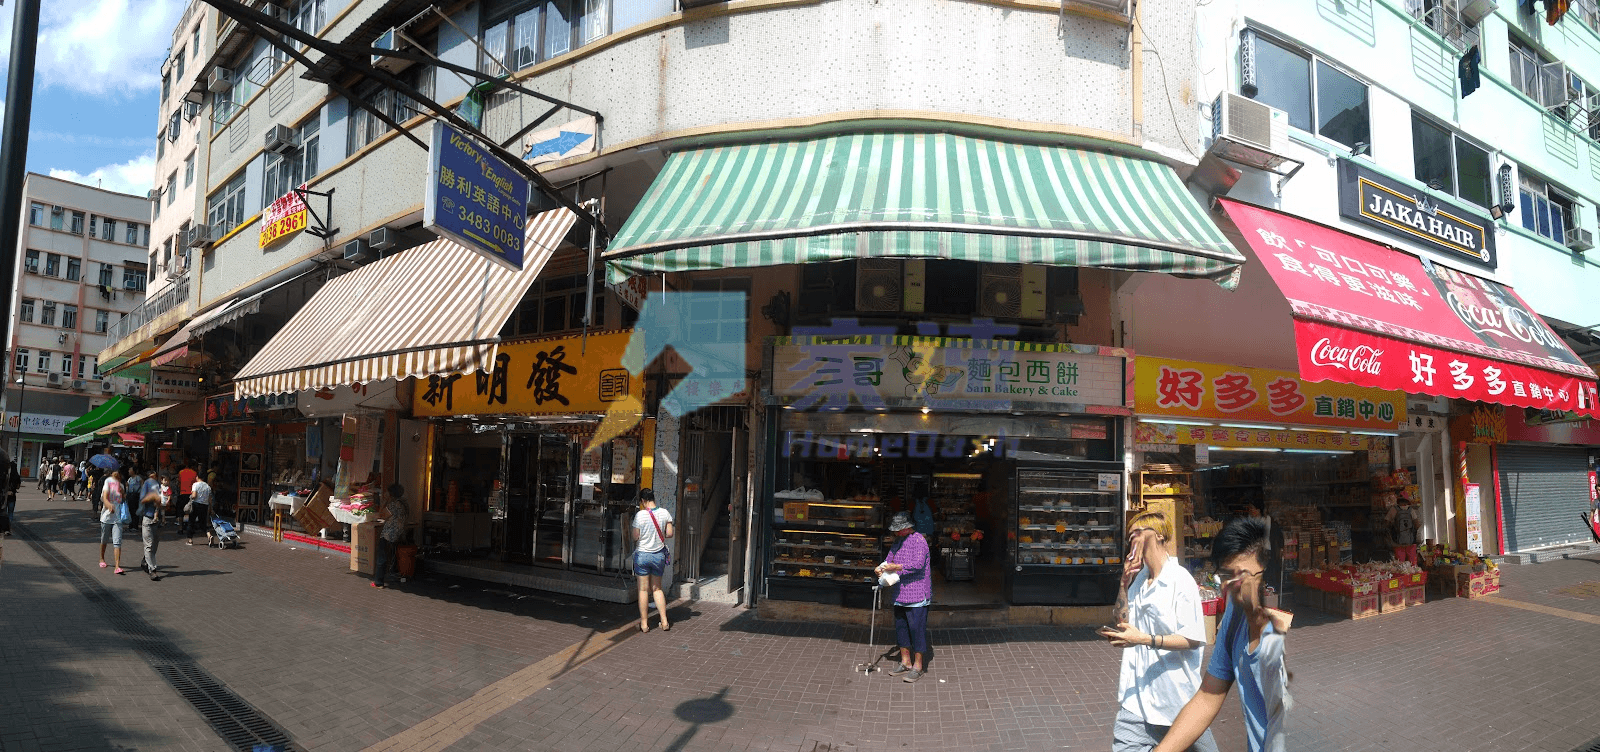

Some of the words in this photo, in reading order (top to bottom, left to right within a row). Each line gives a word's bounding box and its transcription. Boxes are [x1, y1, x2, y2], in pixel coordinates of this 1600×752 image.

[450, 132, 482, 164] Victory
[485, 166, 514, 194] English
[440, 165, 524, 231] 勝利英語中心
[1369, 194, 1427, 232] JAKA
[1427, 216, 1476, 249] HAIR
[280, 211, 304, 235] 2961
[458, 205, 490, 234] 3483
[493, 225, 520, 251] 0083
[813, 356, 884, 387] 三哥
[967, 357, 1079, 385] 麵包西餅
[1310, 338, 1384, 375] Coca-Cola
[1408, 350, 1506, 395] 好多多
[1511, 380, 1570, 402] 直銷中心
[966, 384, 991, 393] Sam
[994, 384, 1035, 396] Bakery
[1037, 385, 1049, 395] &
[1051, 386, 1079, 397] Cake
[1158, 368, 1305, 414] 好多多
[1314, 395, 1394, 420] 直銷中心
